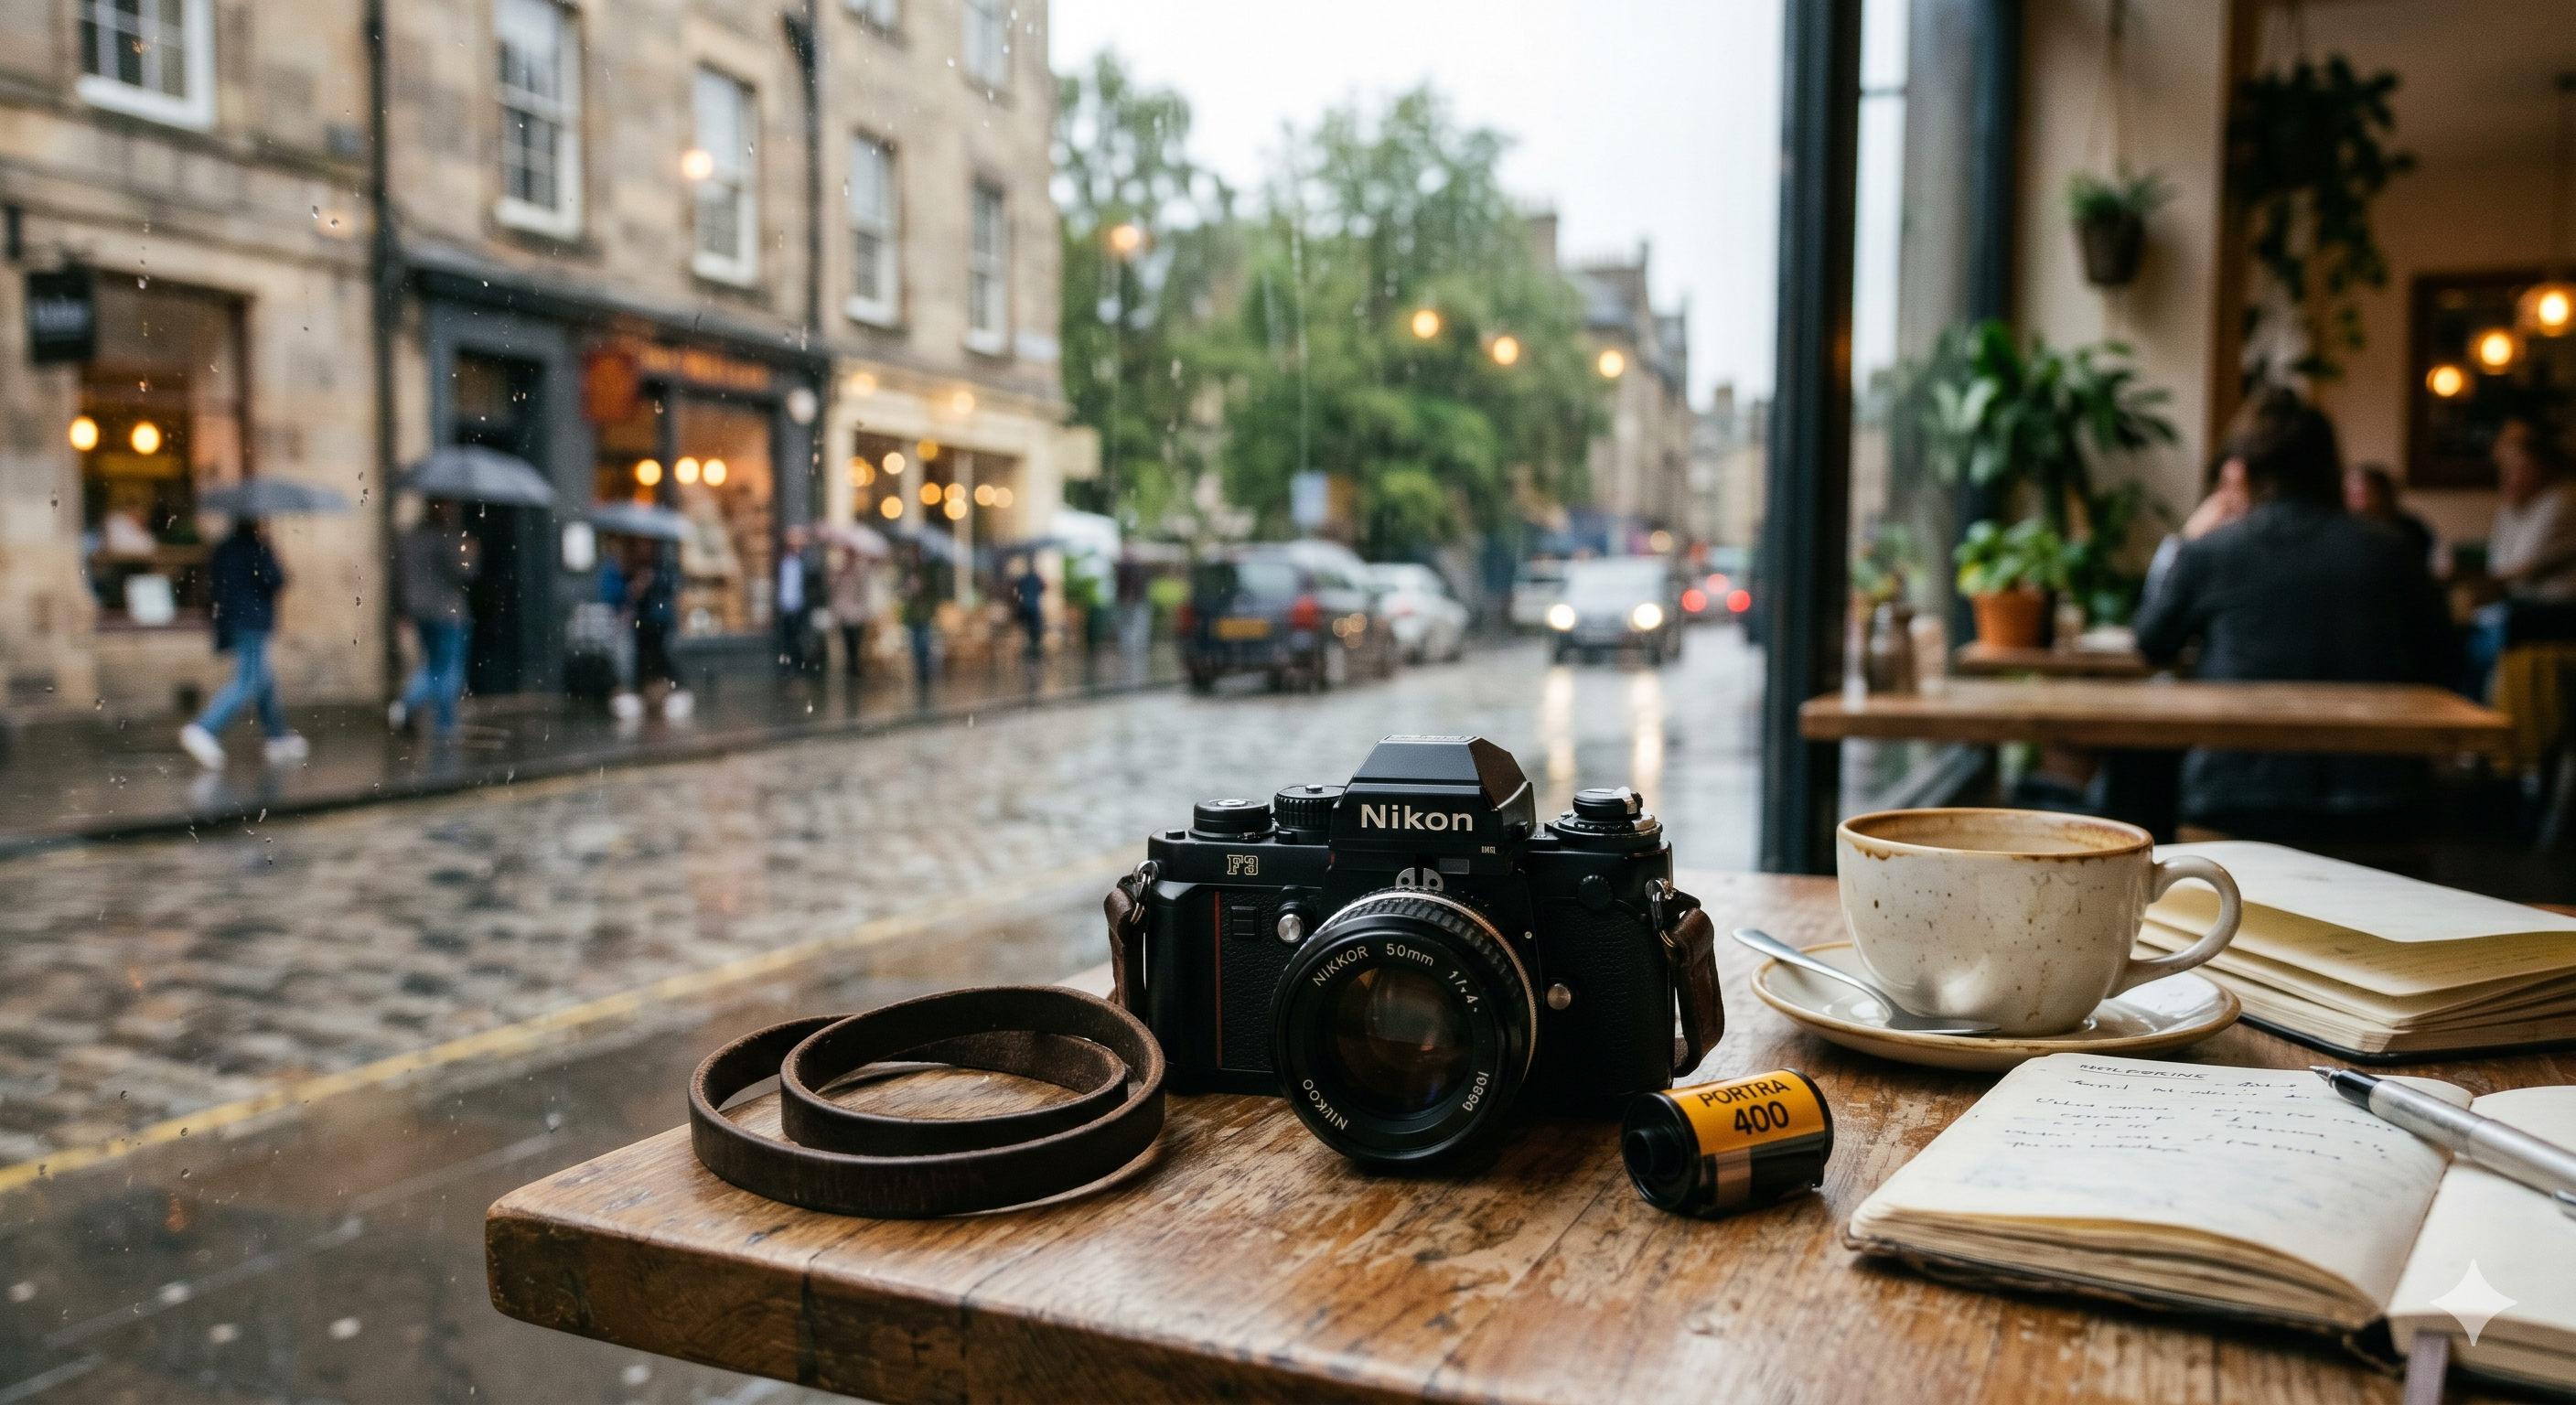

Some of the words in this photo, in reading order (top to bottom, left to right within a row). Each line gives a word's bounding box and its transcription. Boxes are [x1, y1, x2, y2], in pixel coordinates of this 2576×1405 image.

[1361, 804, 1473, 831] Nikon
[1227, 854, 1259, 875] F3
[1313, 946, 1368, 987] NIKKOR
[1386, 943, 1433, 966] 50mm
[1697, 1079, 1791, 1107] PORTRA
[1733, 1100, 1789, 1135] 400
